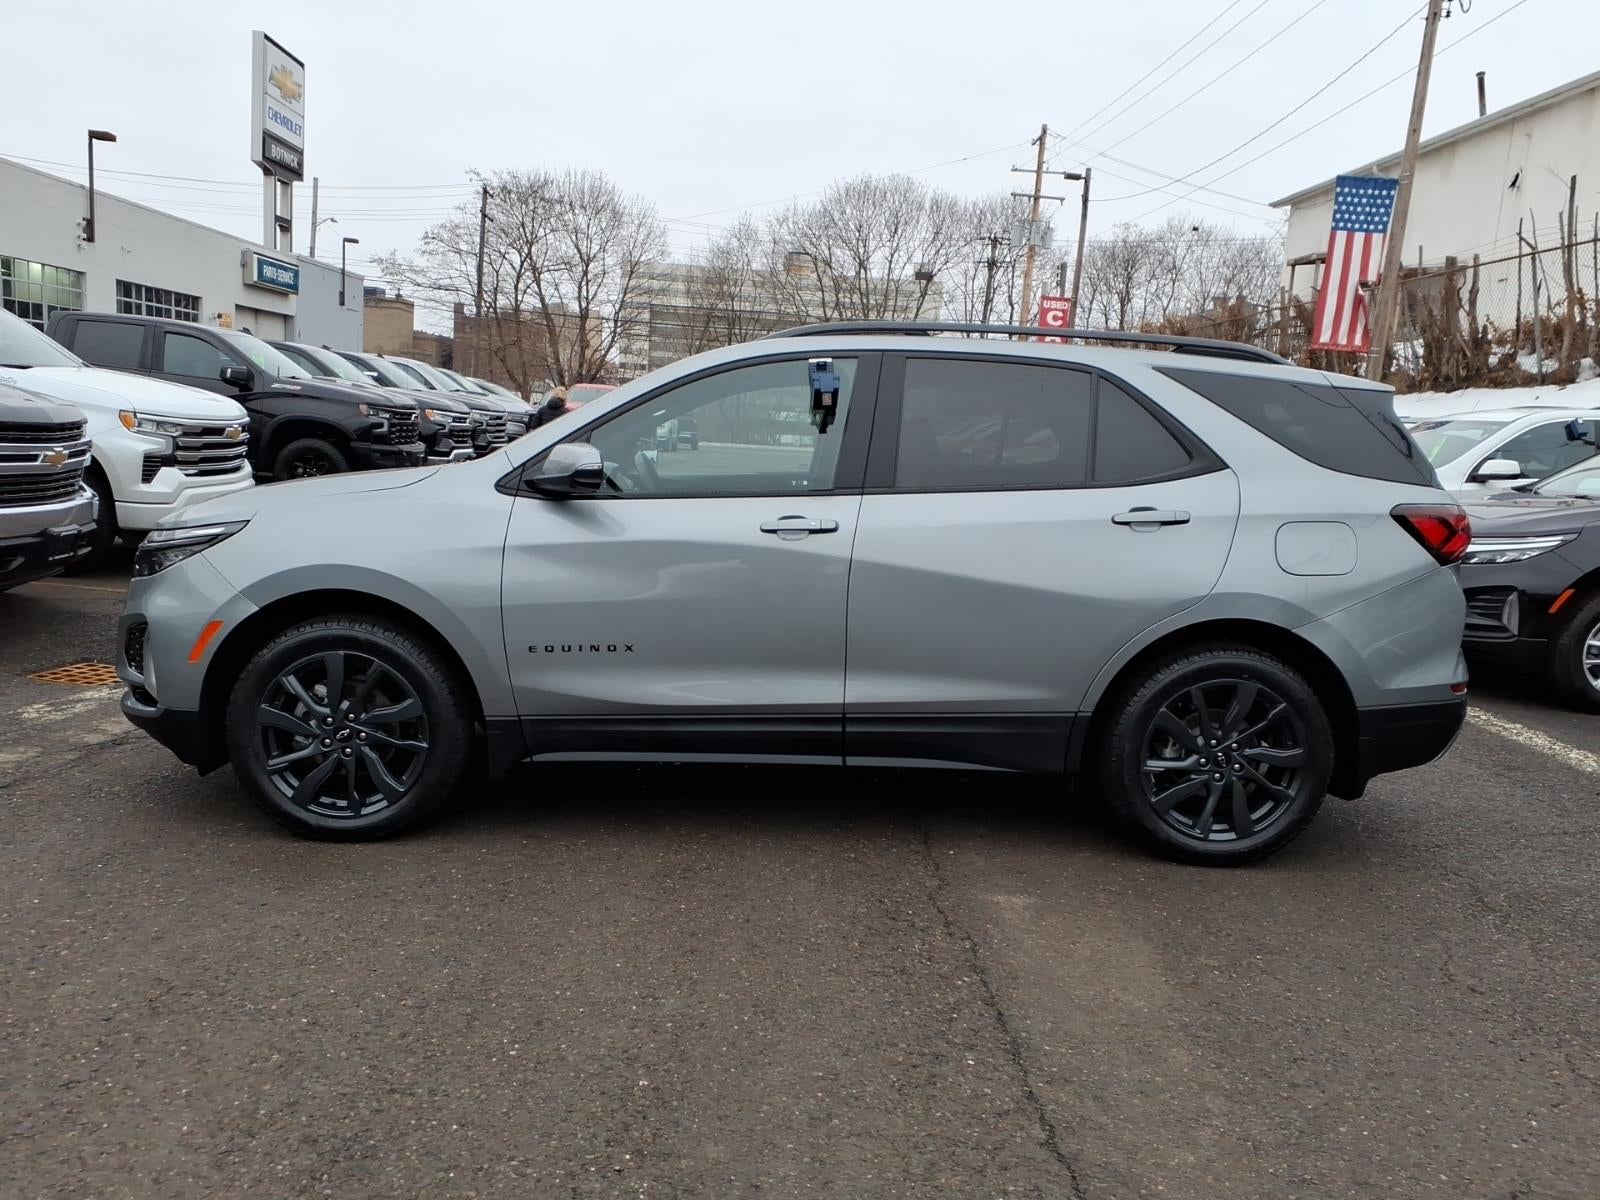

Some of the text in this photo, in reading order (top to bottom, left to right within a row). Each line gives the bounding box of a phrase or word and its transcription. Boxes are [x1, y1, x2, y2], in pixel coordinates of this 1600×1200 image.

[268, 106, 302, 138] CHEVROLET
[271, 144, 299, 169] BOTNICK
[1043, 300, 1069, 310] USED
[528, 645, 634, 653] EQUINOX
